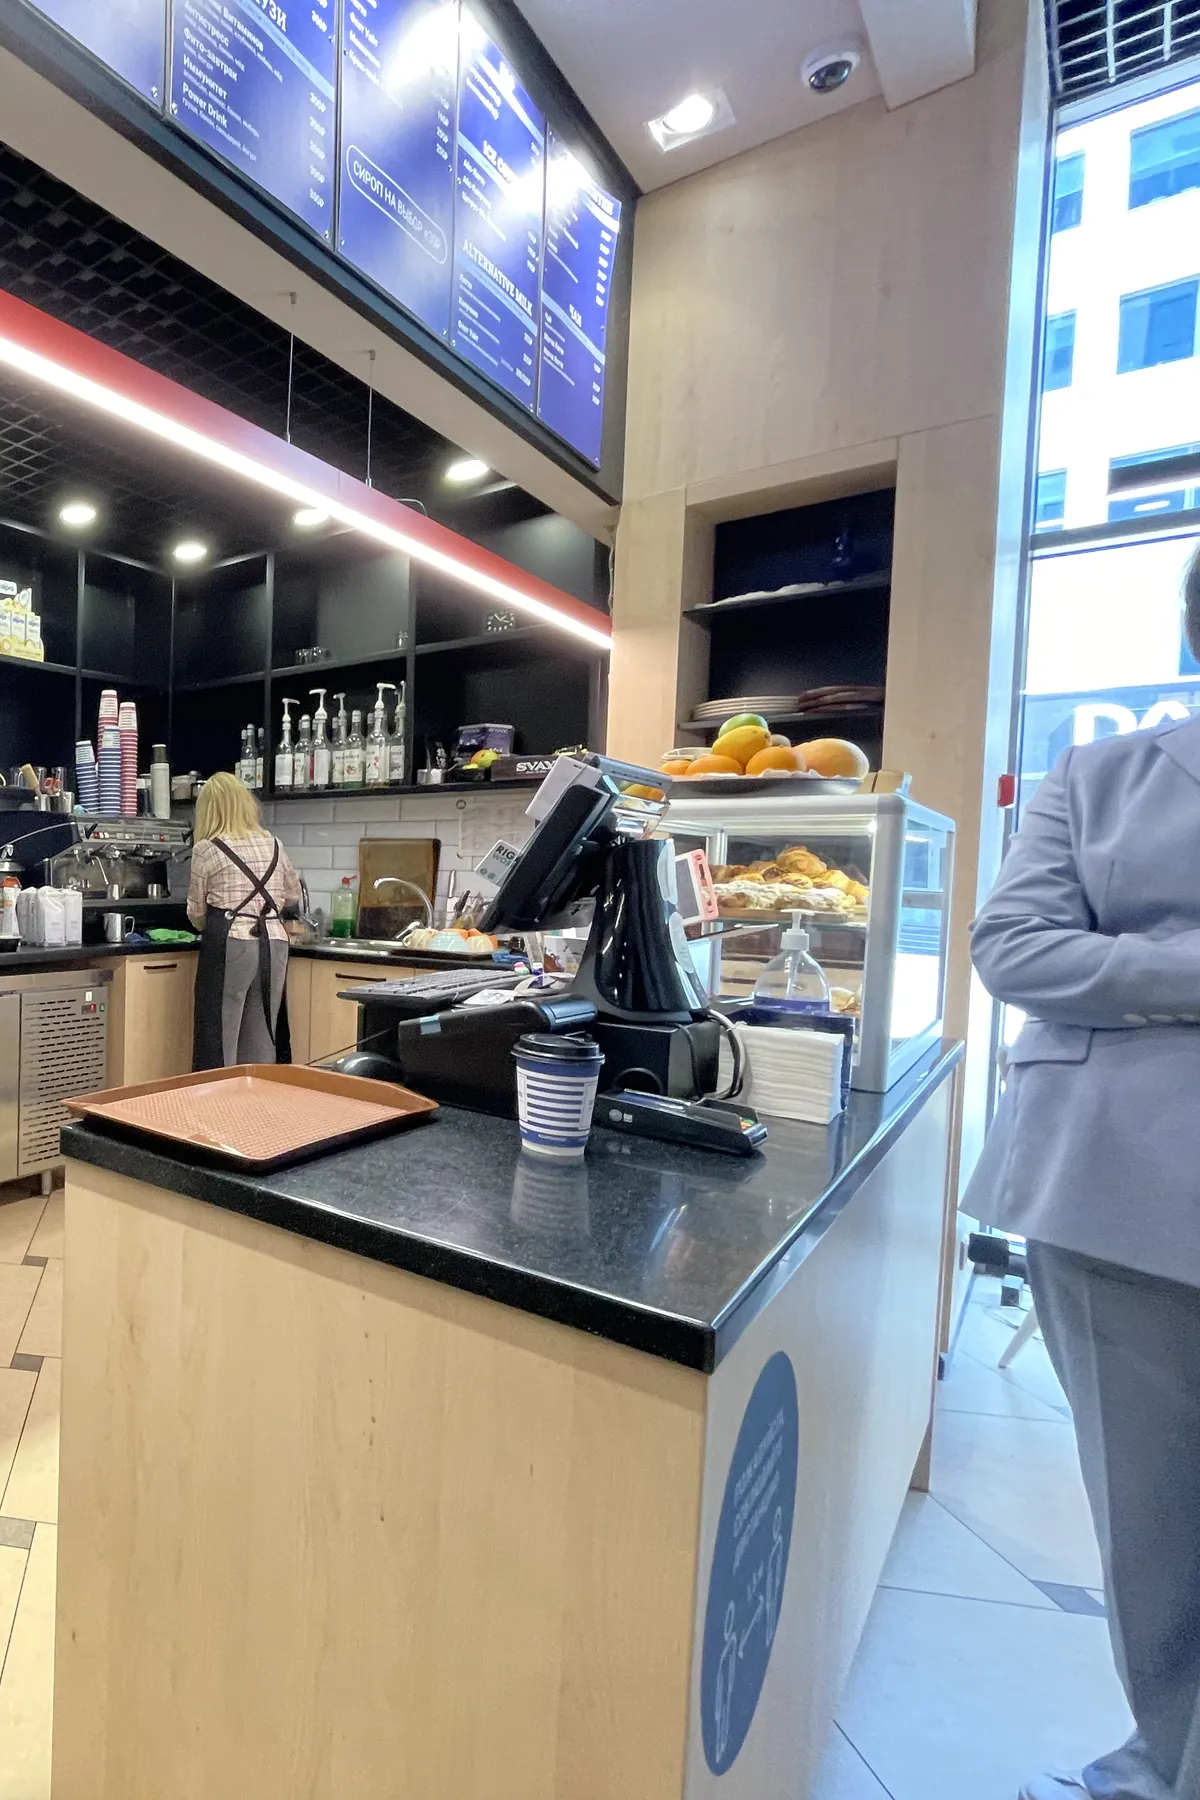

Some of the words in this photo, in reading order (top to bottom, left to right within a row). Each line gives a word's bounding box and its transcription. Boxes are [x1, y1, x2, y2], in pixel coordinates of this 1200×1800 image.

[184, 1, 229, 47] Антистресс
[224, 7, 264, 52] Витаминов
[183, 54, 228, 100] Иммунитет
[184, 27, 238, 82] Фито-завтрак
[182, 81, 207, 109] Power
[208, 102, 228, 128] Drink
[353, 160, 383, 198] СИРОП
[384, 187, 397, 210] НА
[397, 199, 423, 233] ВЫБОР
[462, 239, 515, 298] ALTERNATIVE
[515, 288, 533, 317] MILK
